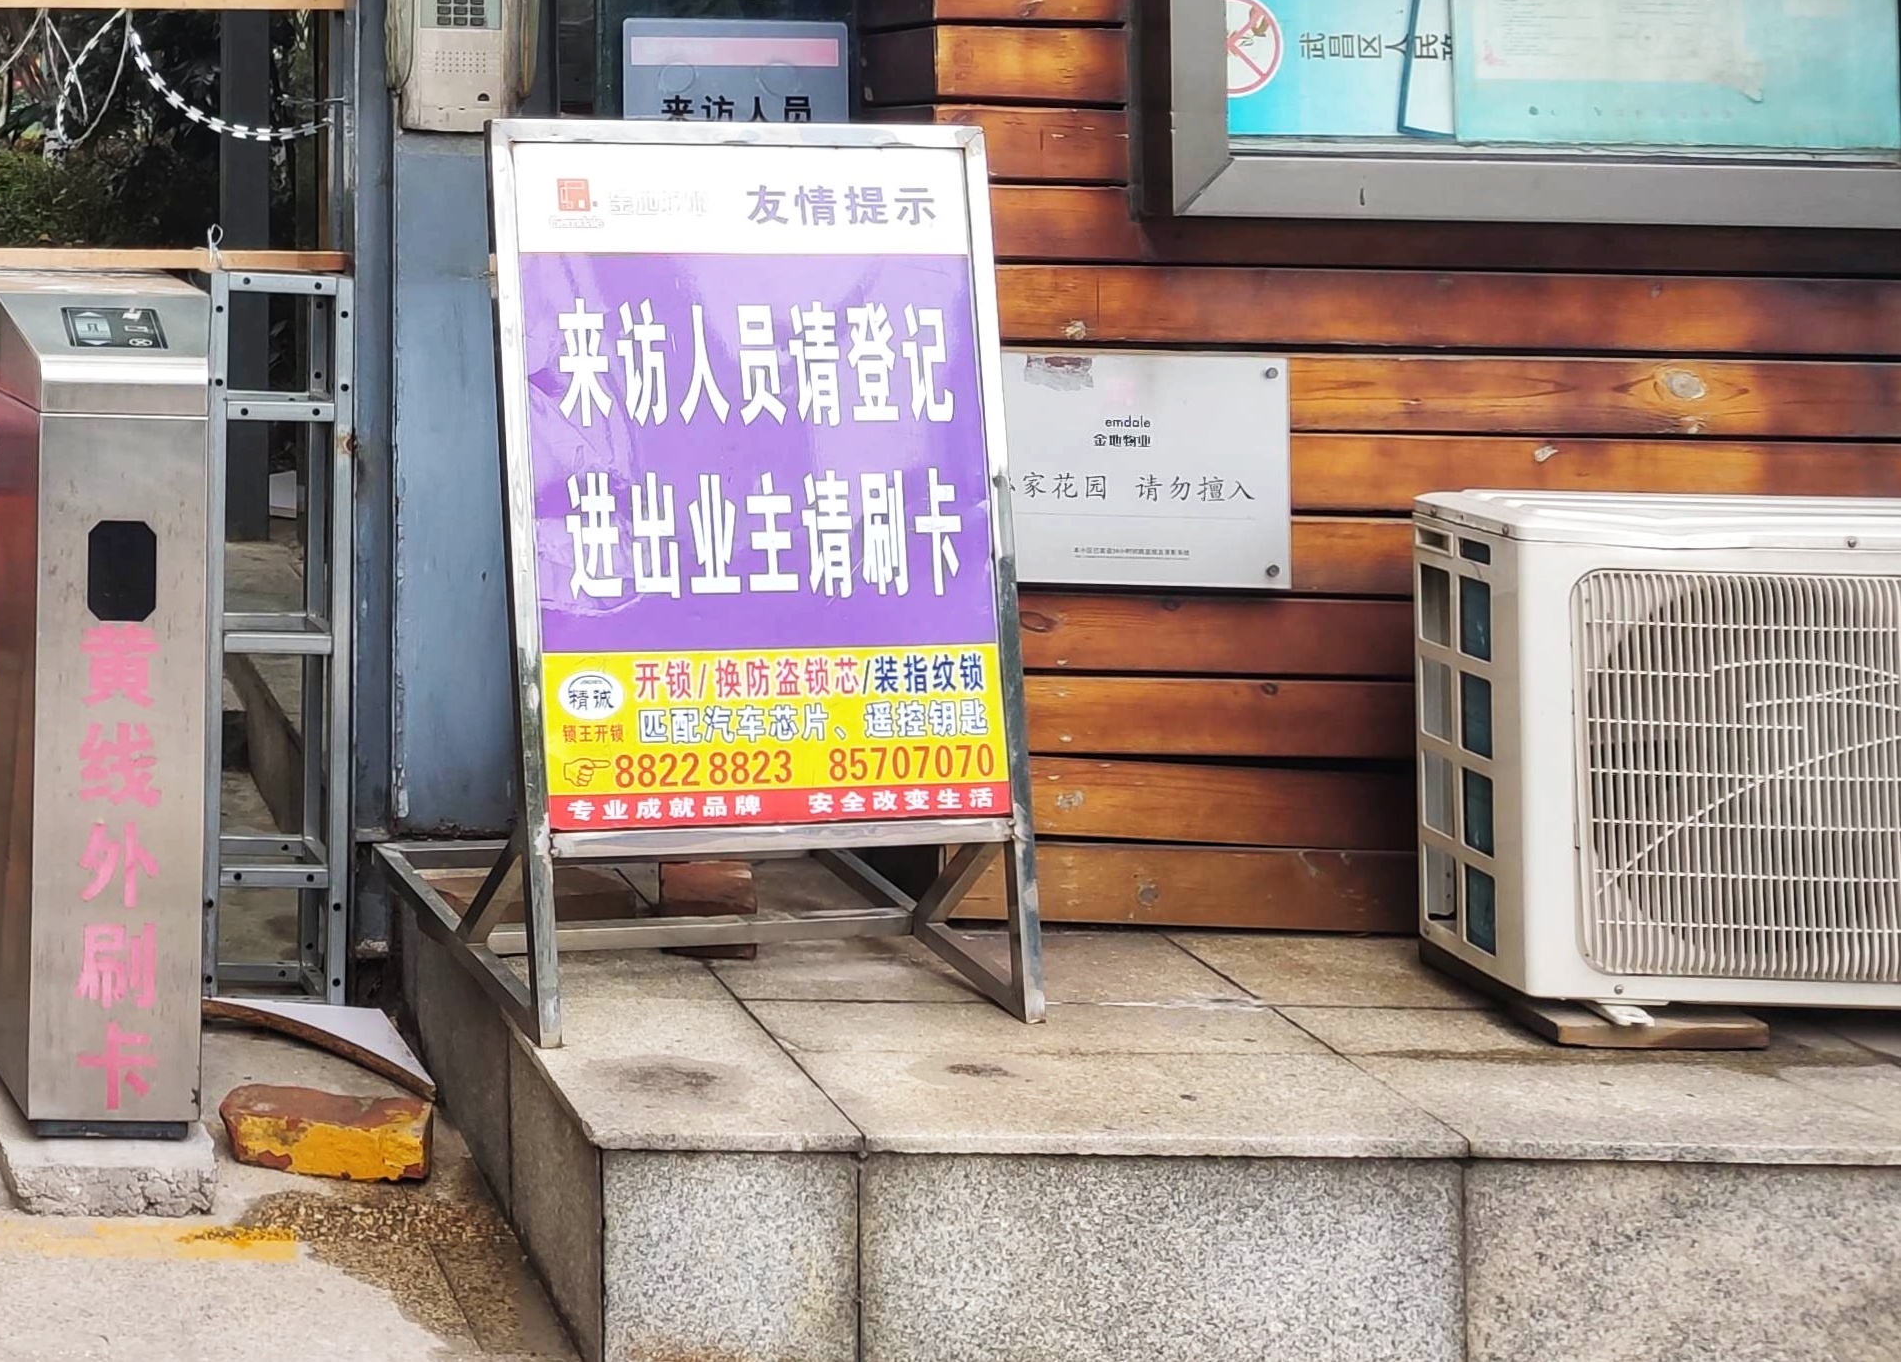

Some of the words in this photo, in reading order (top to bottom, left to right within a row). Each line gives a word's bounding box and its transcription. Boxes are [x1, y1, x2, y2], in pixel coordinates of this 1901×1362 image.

[745, 184, 937, 226] 友情提示
[557, 298, 956, 427] 来访人员请登记
[1134, 473, 1256, 502] 请勿擅入
[565, 468, 963, 600] 进出业主请刷卡
[568, 689, 615, 711] 精诚
[562, 723, 625, 744] 锁王开锁
[828, 743, 996, 782] 85707070
[566, 796, 763, 822] 专业成就品牌
[807, 787, 995, 814] 安全改变生活
[75, 621, 162, 1112] 黄线外刷卡
